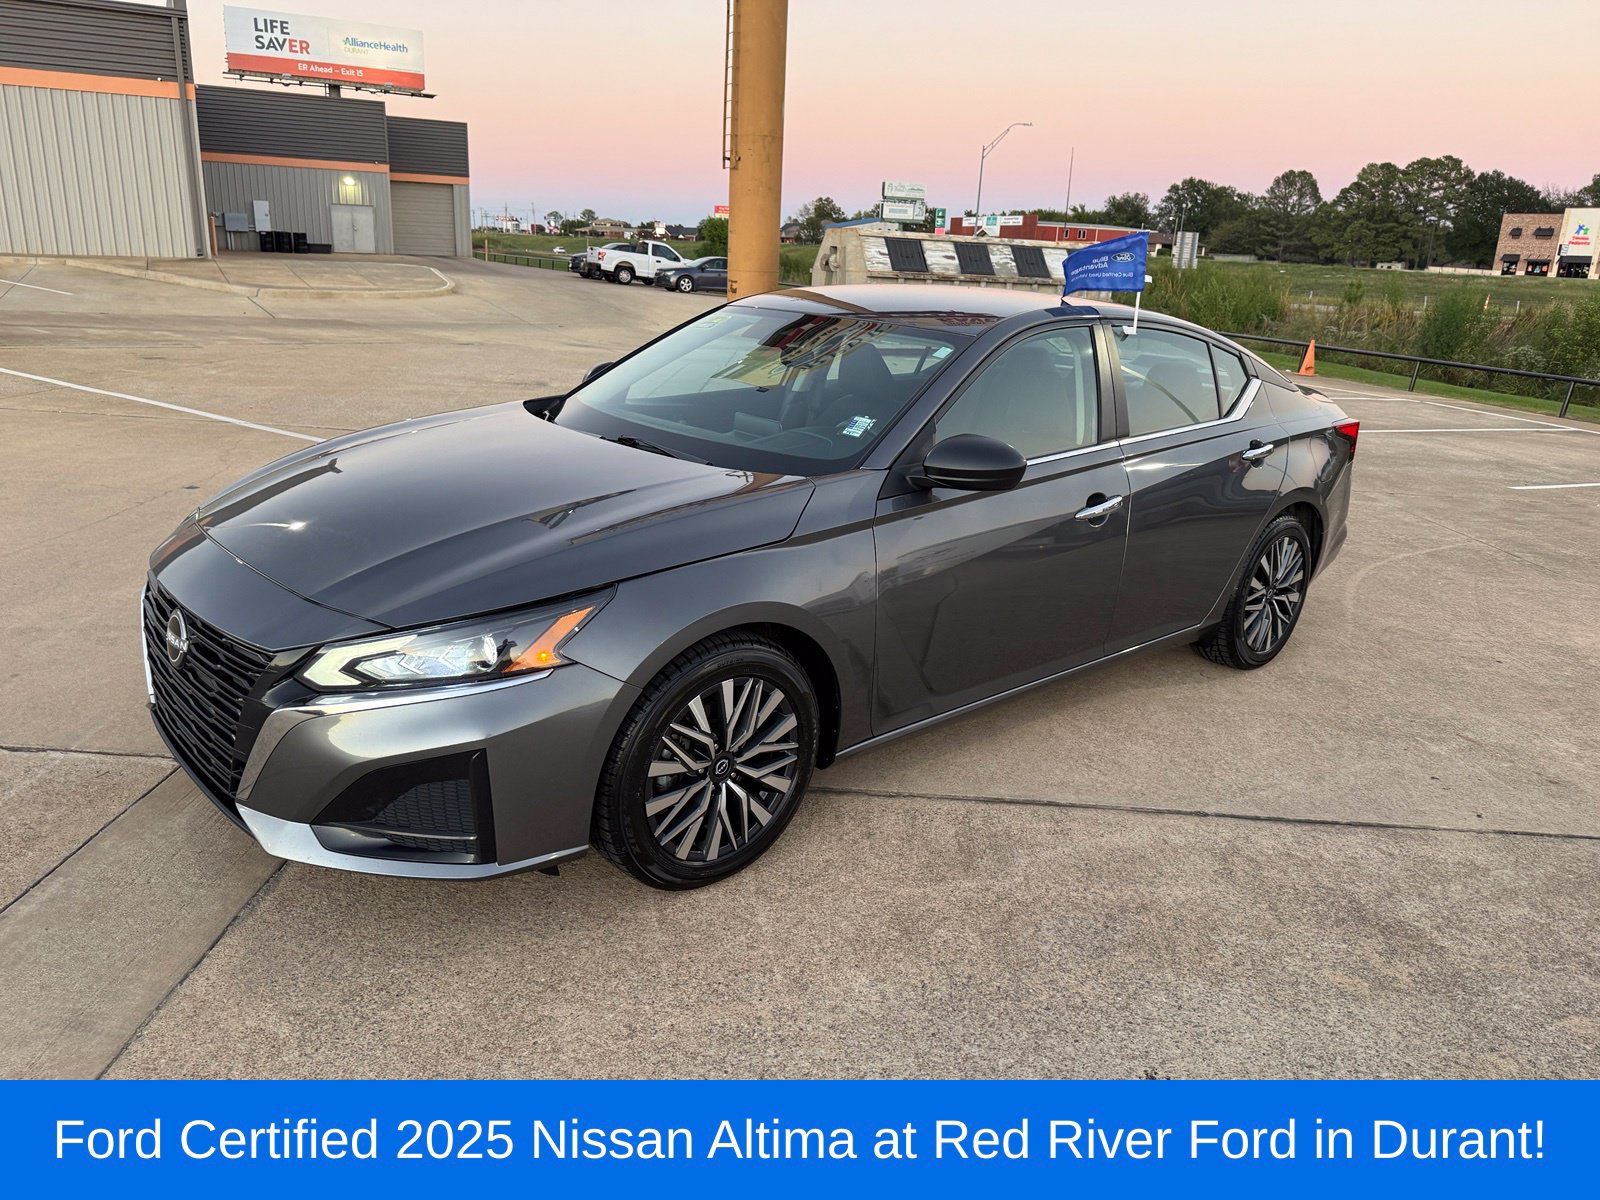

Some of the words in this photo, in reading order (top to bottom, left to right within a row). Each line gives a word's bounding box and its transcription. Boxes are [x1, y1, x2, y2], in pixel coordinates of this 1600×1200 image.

[254, 17, 290, 35] LIFE
[255, 35, 310, 55] SAVER
[343, 37, 408, 53] AllianceHealth
[298, 63, 308, 71] ER
[310, 64, 333, 73] Ahead
[341, 68, 355, 76] Exit
[356, 69, 364, 77] 15
